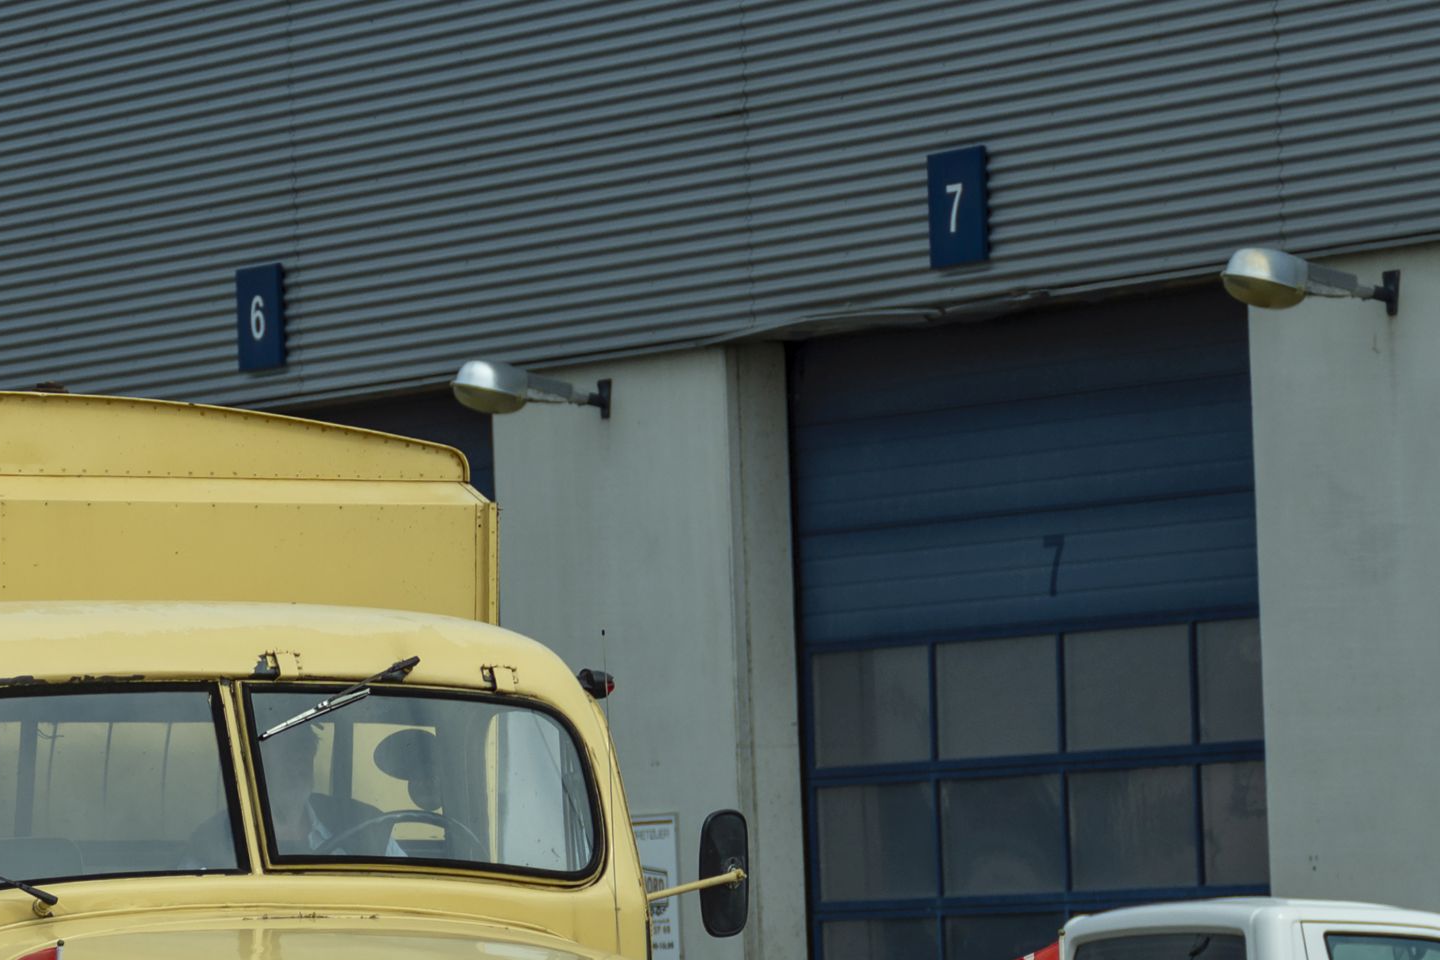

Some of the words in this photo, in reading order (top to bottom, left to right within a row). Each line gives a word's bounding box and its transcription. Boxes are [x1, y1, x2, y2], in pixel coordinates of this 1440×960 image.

[945, 182, 963, 234] 7
[250, 295, 265, 340] 6
[1042, 533, 1065, 598] 7
